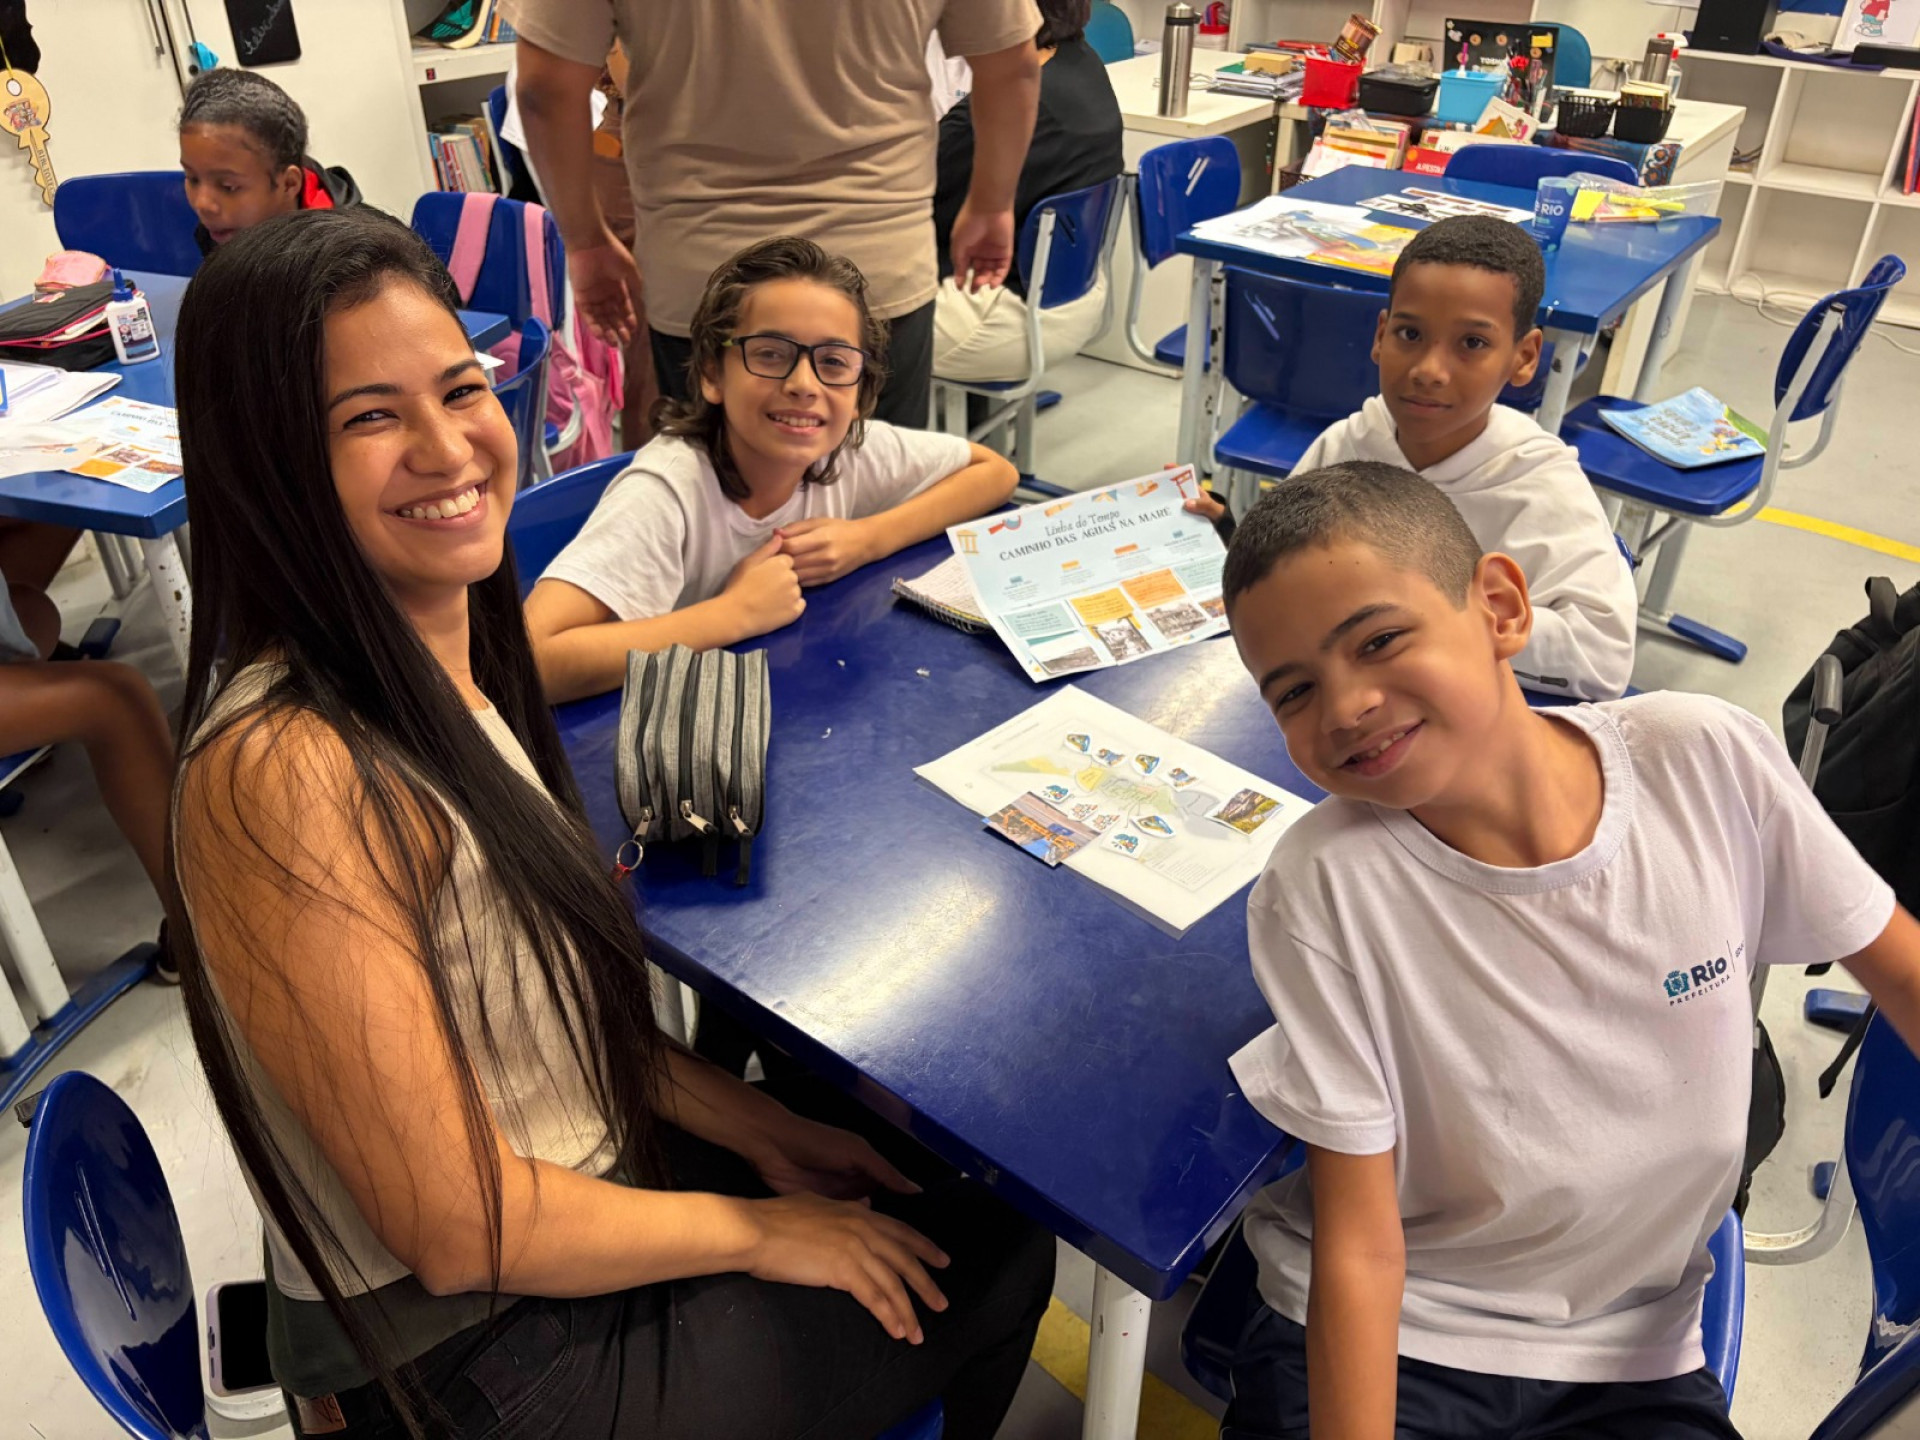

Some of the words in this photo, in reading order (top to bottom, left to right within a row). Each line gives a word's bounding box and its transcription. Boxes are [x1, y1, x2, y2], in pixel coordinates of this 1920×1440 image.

[1541, 203, 1564, 216] RIO
[1075, 514, 1087, 529] do
[1089, 510, 1120, 525] Tempo
[999, 539, 1052, 562] CAMINHO
[1055, 533, 1078, 546] DAS
[1119, 517, 1135, 529] NA
[1690, 957, 1727, 987] Rio
[1669, 974, 1731, 1007] PREFEITURA
